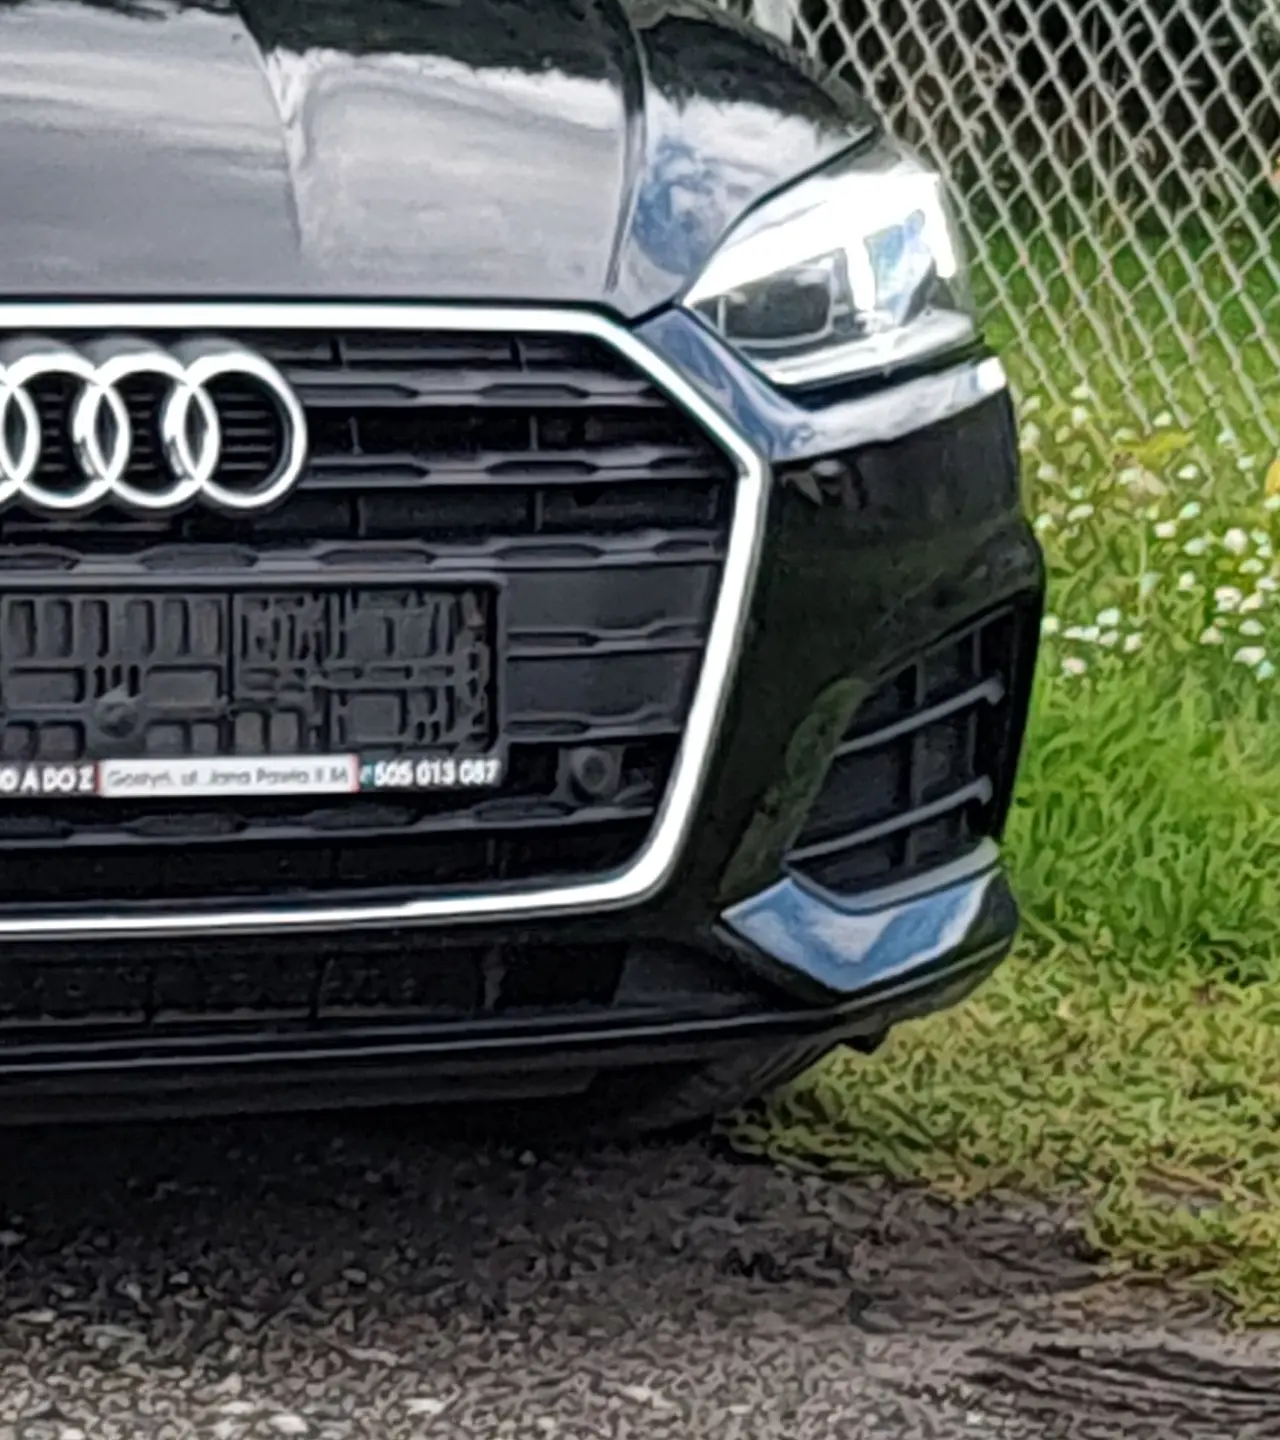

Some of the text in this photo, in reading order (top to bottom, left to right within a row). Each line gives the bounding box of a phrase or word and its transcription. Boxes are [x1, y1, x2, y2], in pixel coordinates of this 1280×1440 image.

[20, 765, 40, 793] A
[43, 765, 76, 792] DO
[78, 764, 94, 791] Z
